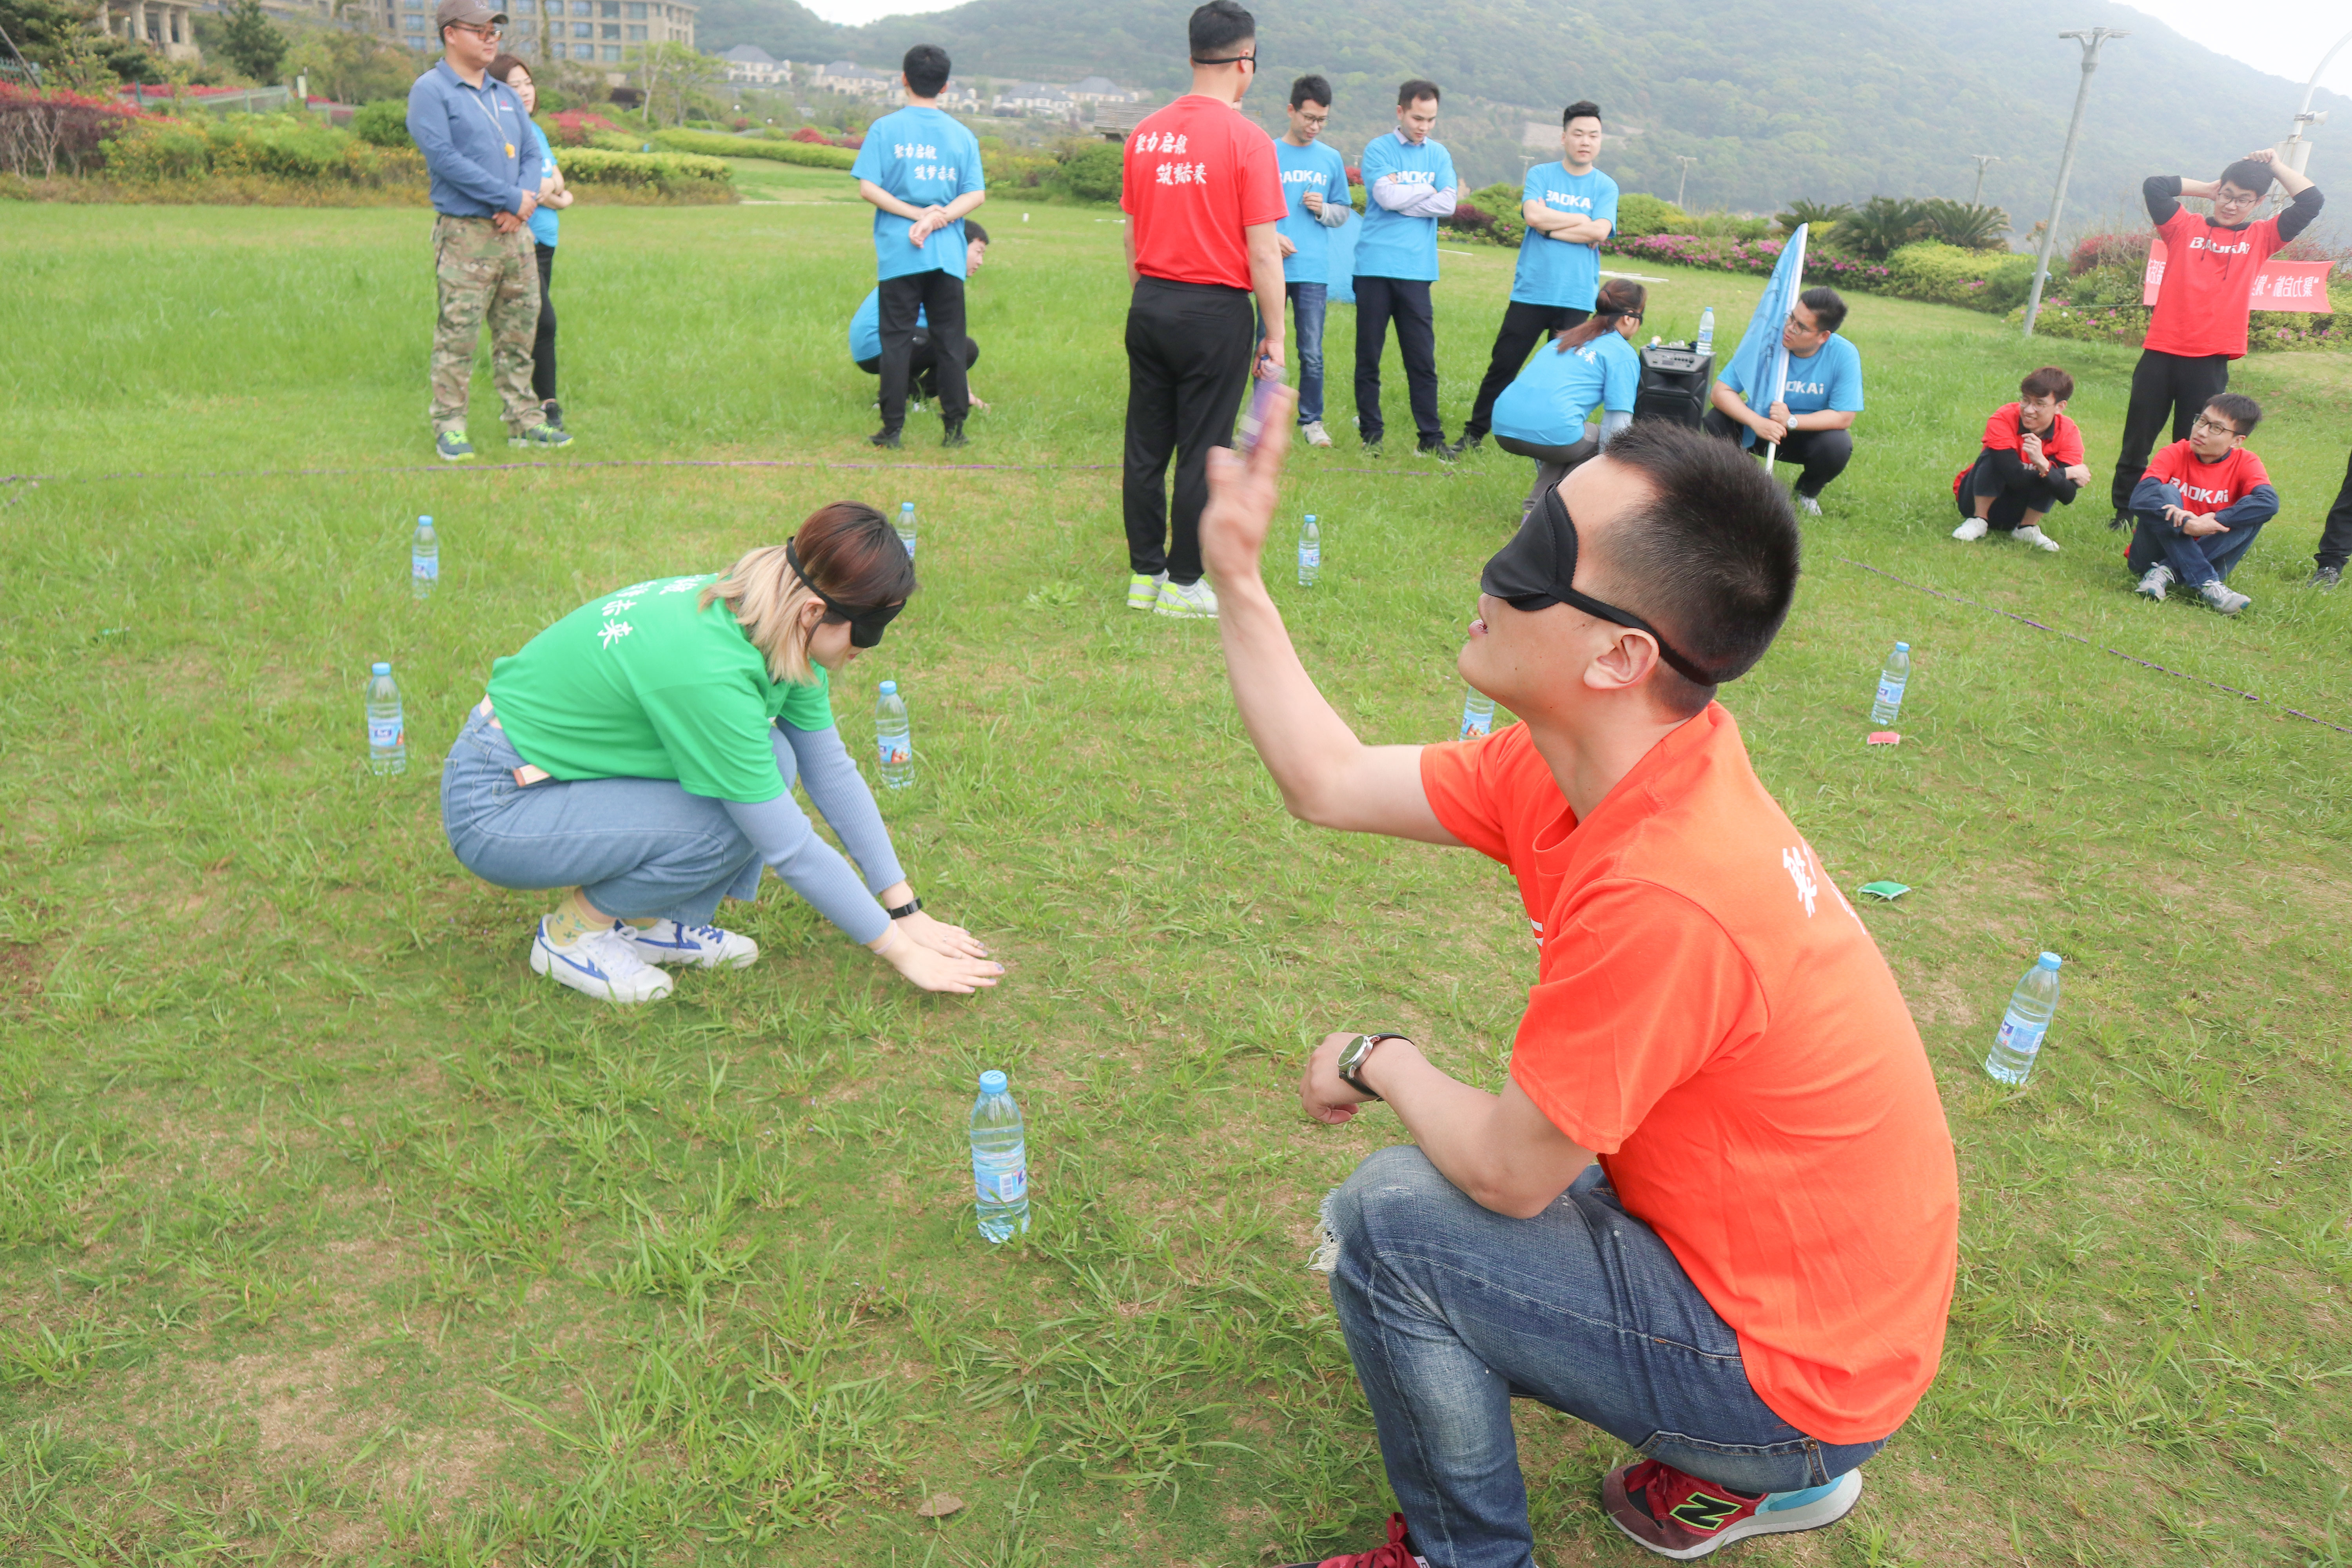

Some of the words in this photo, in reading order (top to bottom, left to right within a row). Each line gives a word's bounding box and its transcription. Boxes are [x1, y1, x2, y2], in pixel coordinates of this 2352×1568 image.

[894, 143, 937, 160] 聚力启航
[1135, 131, 1188, 154] 聚力启航
[1670, 1491, 1742, 1530] N
